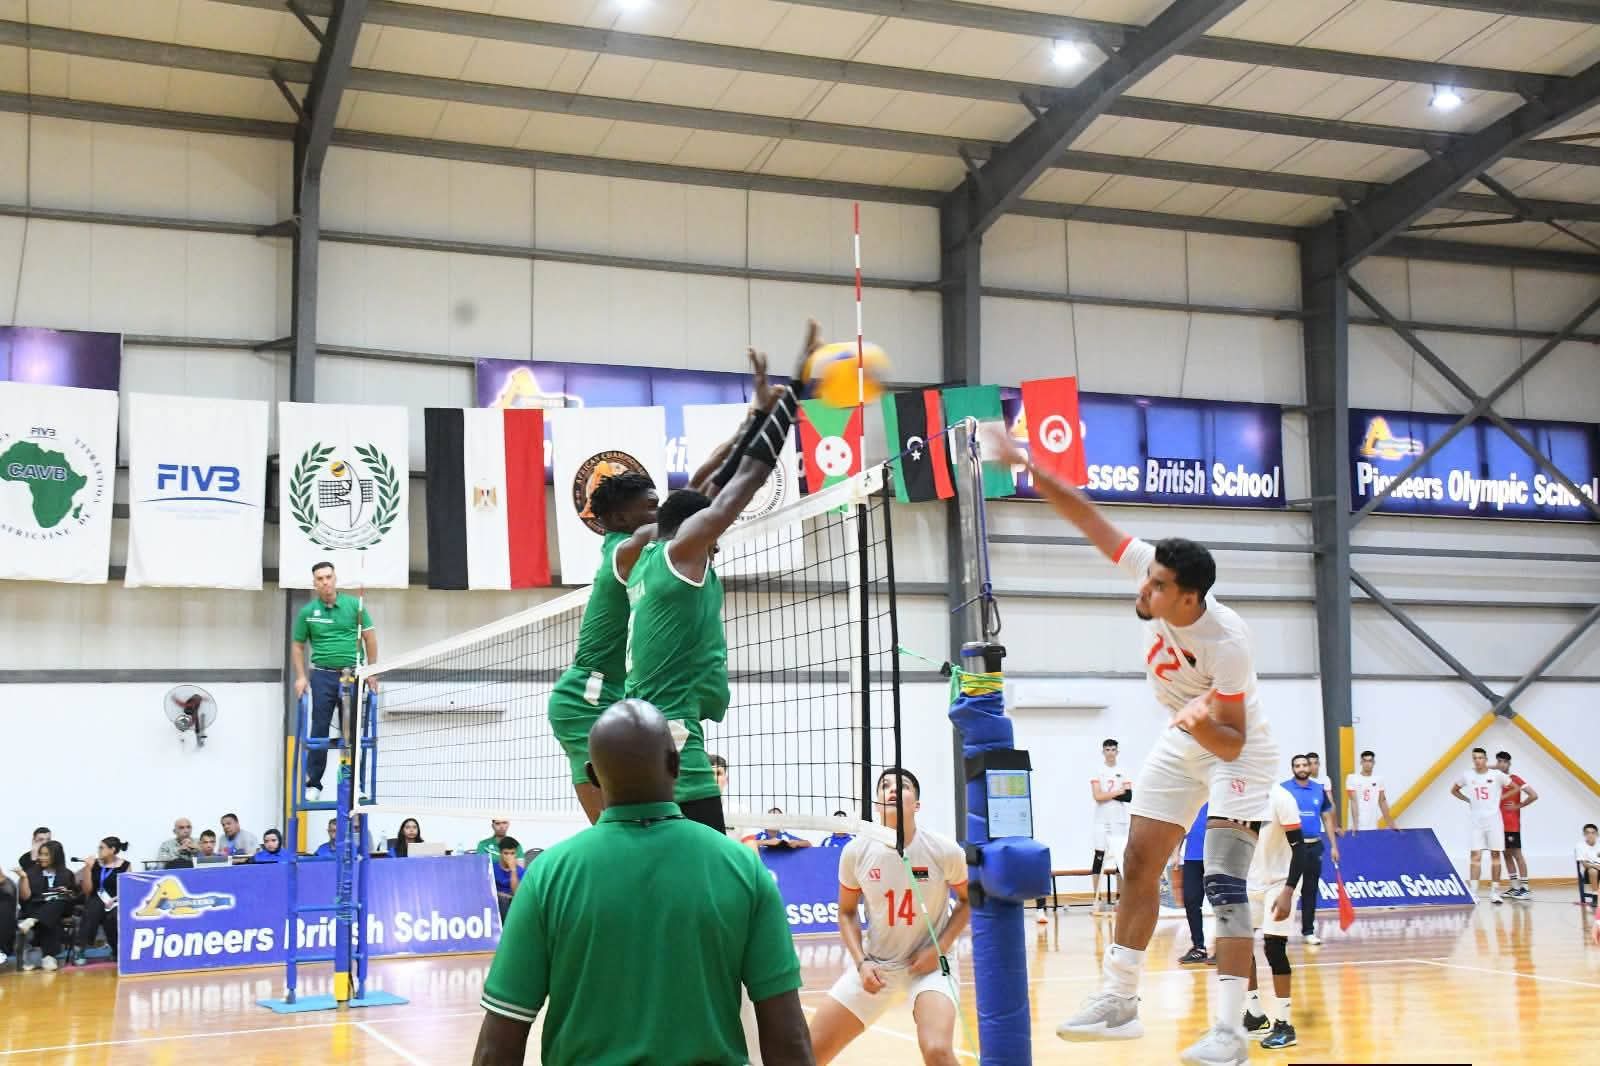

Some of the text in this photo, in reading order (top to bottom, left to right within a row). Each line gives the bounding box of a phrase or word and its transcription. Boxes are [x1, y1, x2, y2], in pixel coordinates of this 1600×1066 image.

[31, 427, 56, 437] FIVB
[8, 462, 67, 481] CAVB
[157, 463, 241, 493] FIVB
[1145, 459, 1206, 495] British
[1212, 463, 1280, 499] School
[1448, 470, 1529, 511] Olympic
[1474, 786, 1489, 801] 15
[1400, 873, 1467, 897] School
[884, 888, 917, 928] 14
[131, 926, 274, 960] Pioneers
[393, 906, 492, 942] School
